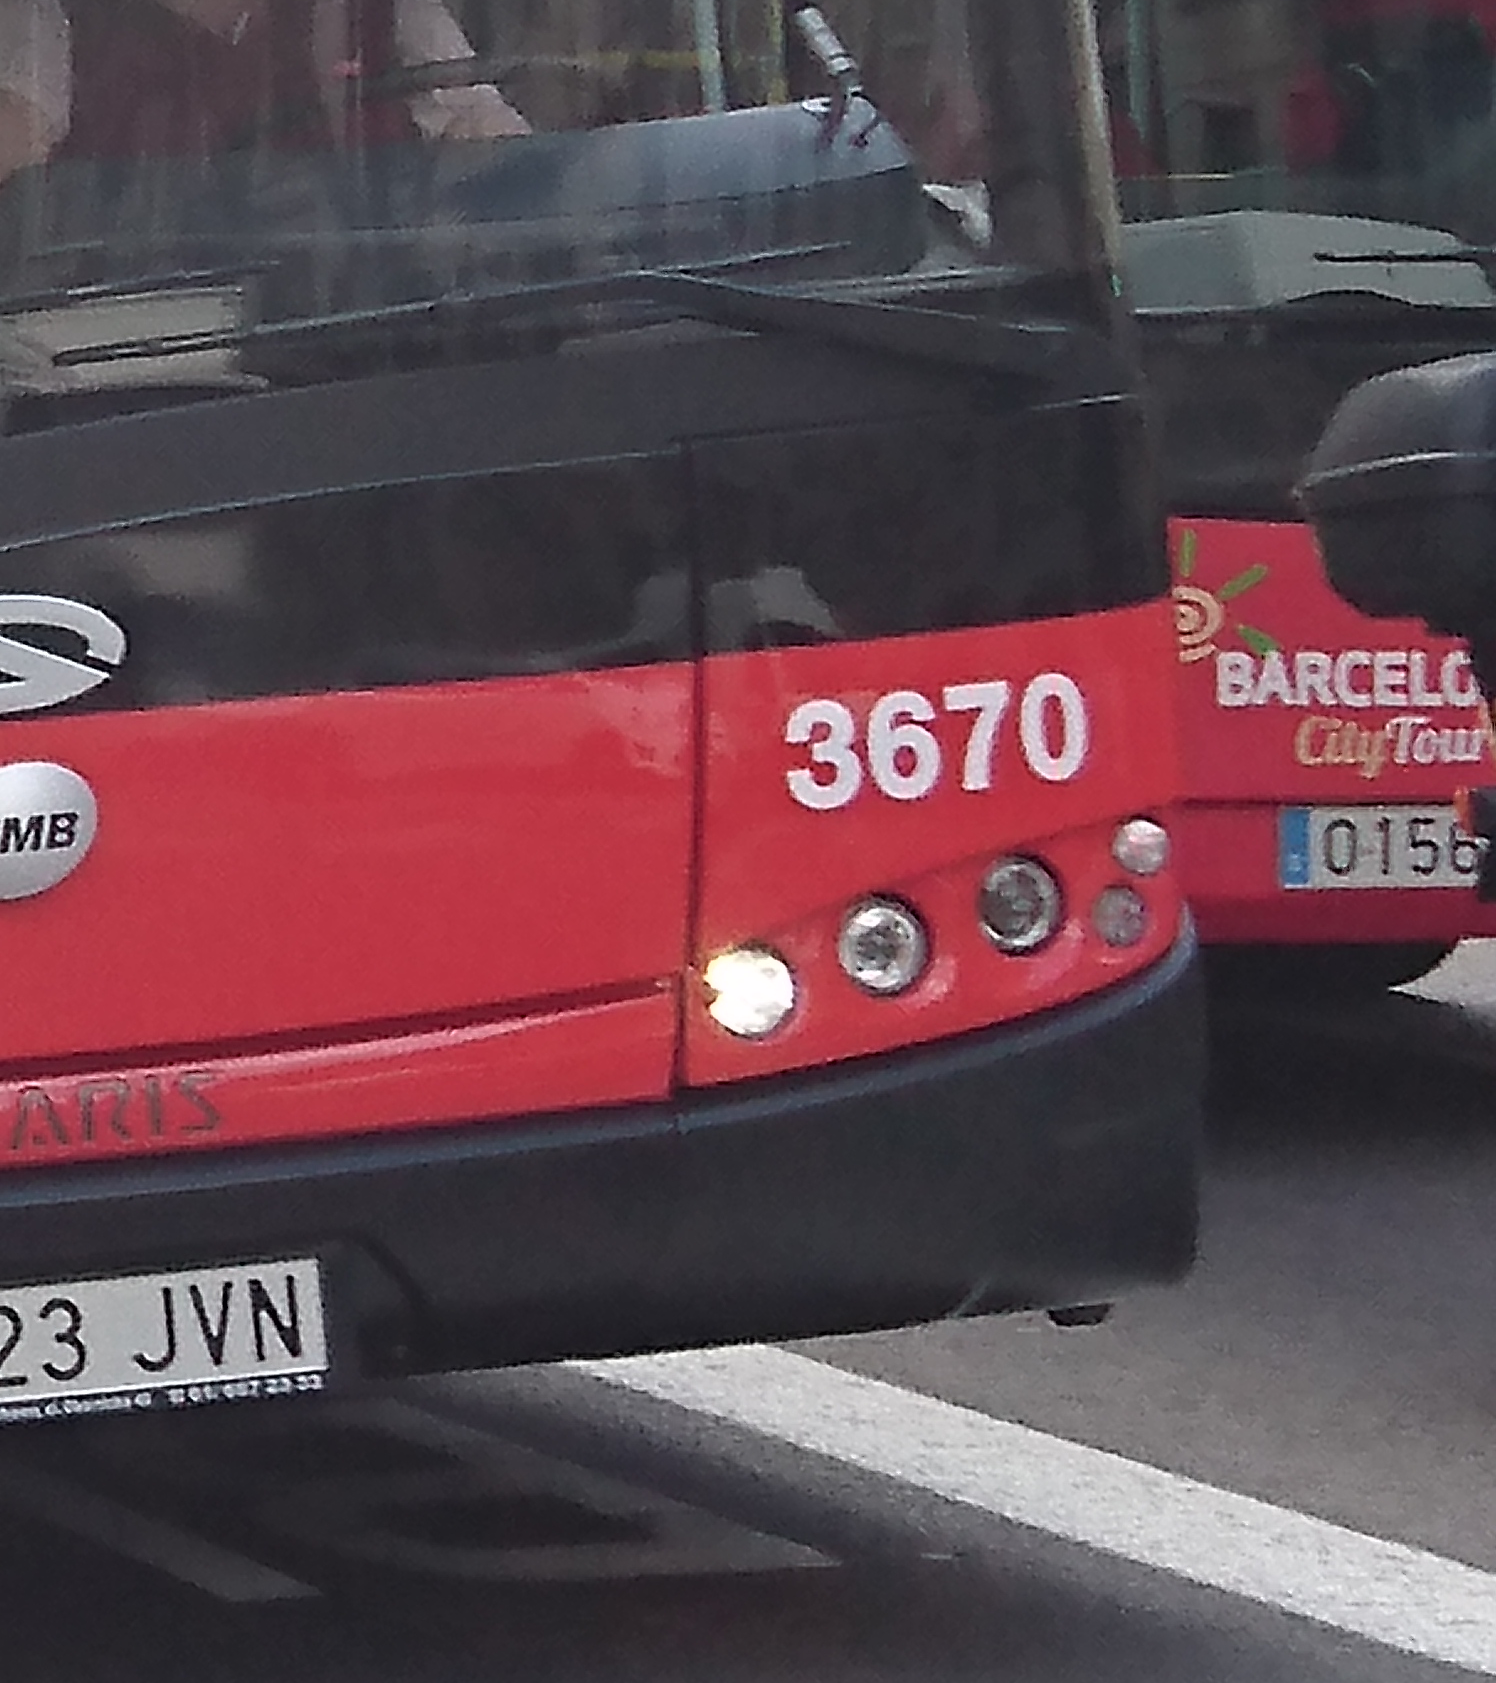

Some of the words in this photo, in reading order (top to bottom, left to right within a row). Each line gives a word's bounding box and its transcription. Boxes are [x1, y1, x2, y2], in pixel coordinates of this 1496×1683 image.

[784, 671, 1089, 811] 3670
[1322, 816, 1479, 876] 0156
[131, 1273, 304, 1373] JVN
